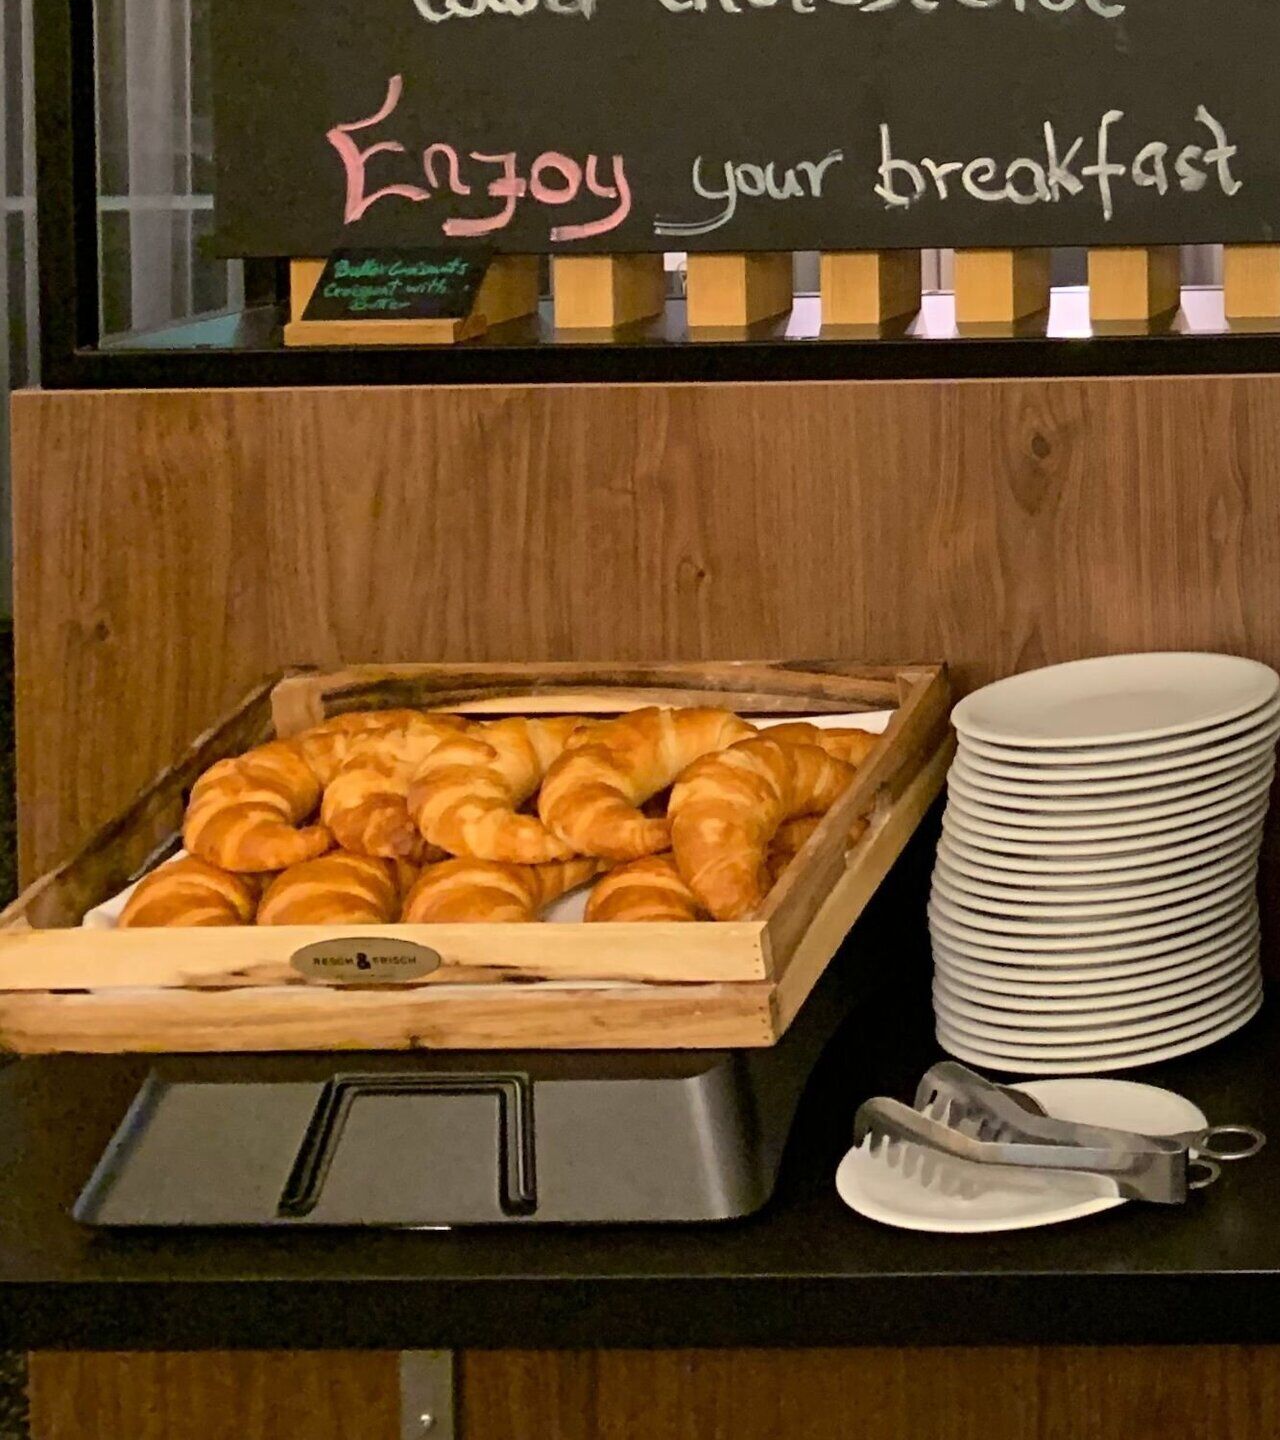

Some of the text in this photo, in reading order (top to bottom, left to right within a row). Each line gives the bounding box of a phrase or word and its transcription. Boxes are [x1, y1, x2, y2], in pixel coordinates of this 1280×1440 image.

[326, 74, 1242, 242] Enjoy your breakfast
[356, 952, 371, 970] &
[372, 955, 417, 965] FRISCH
